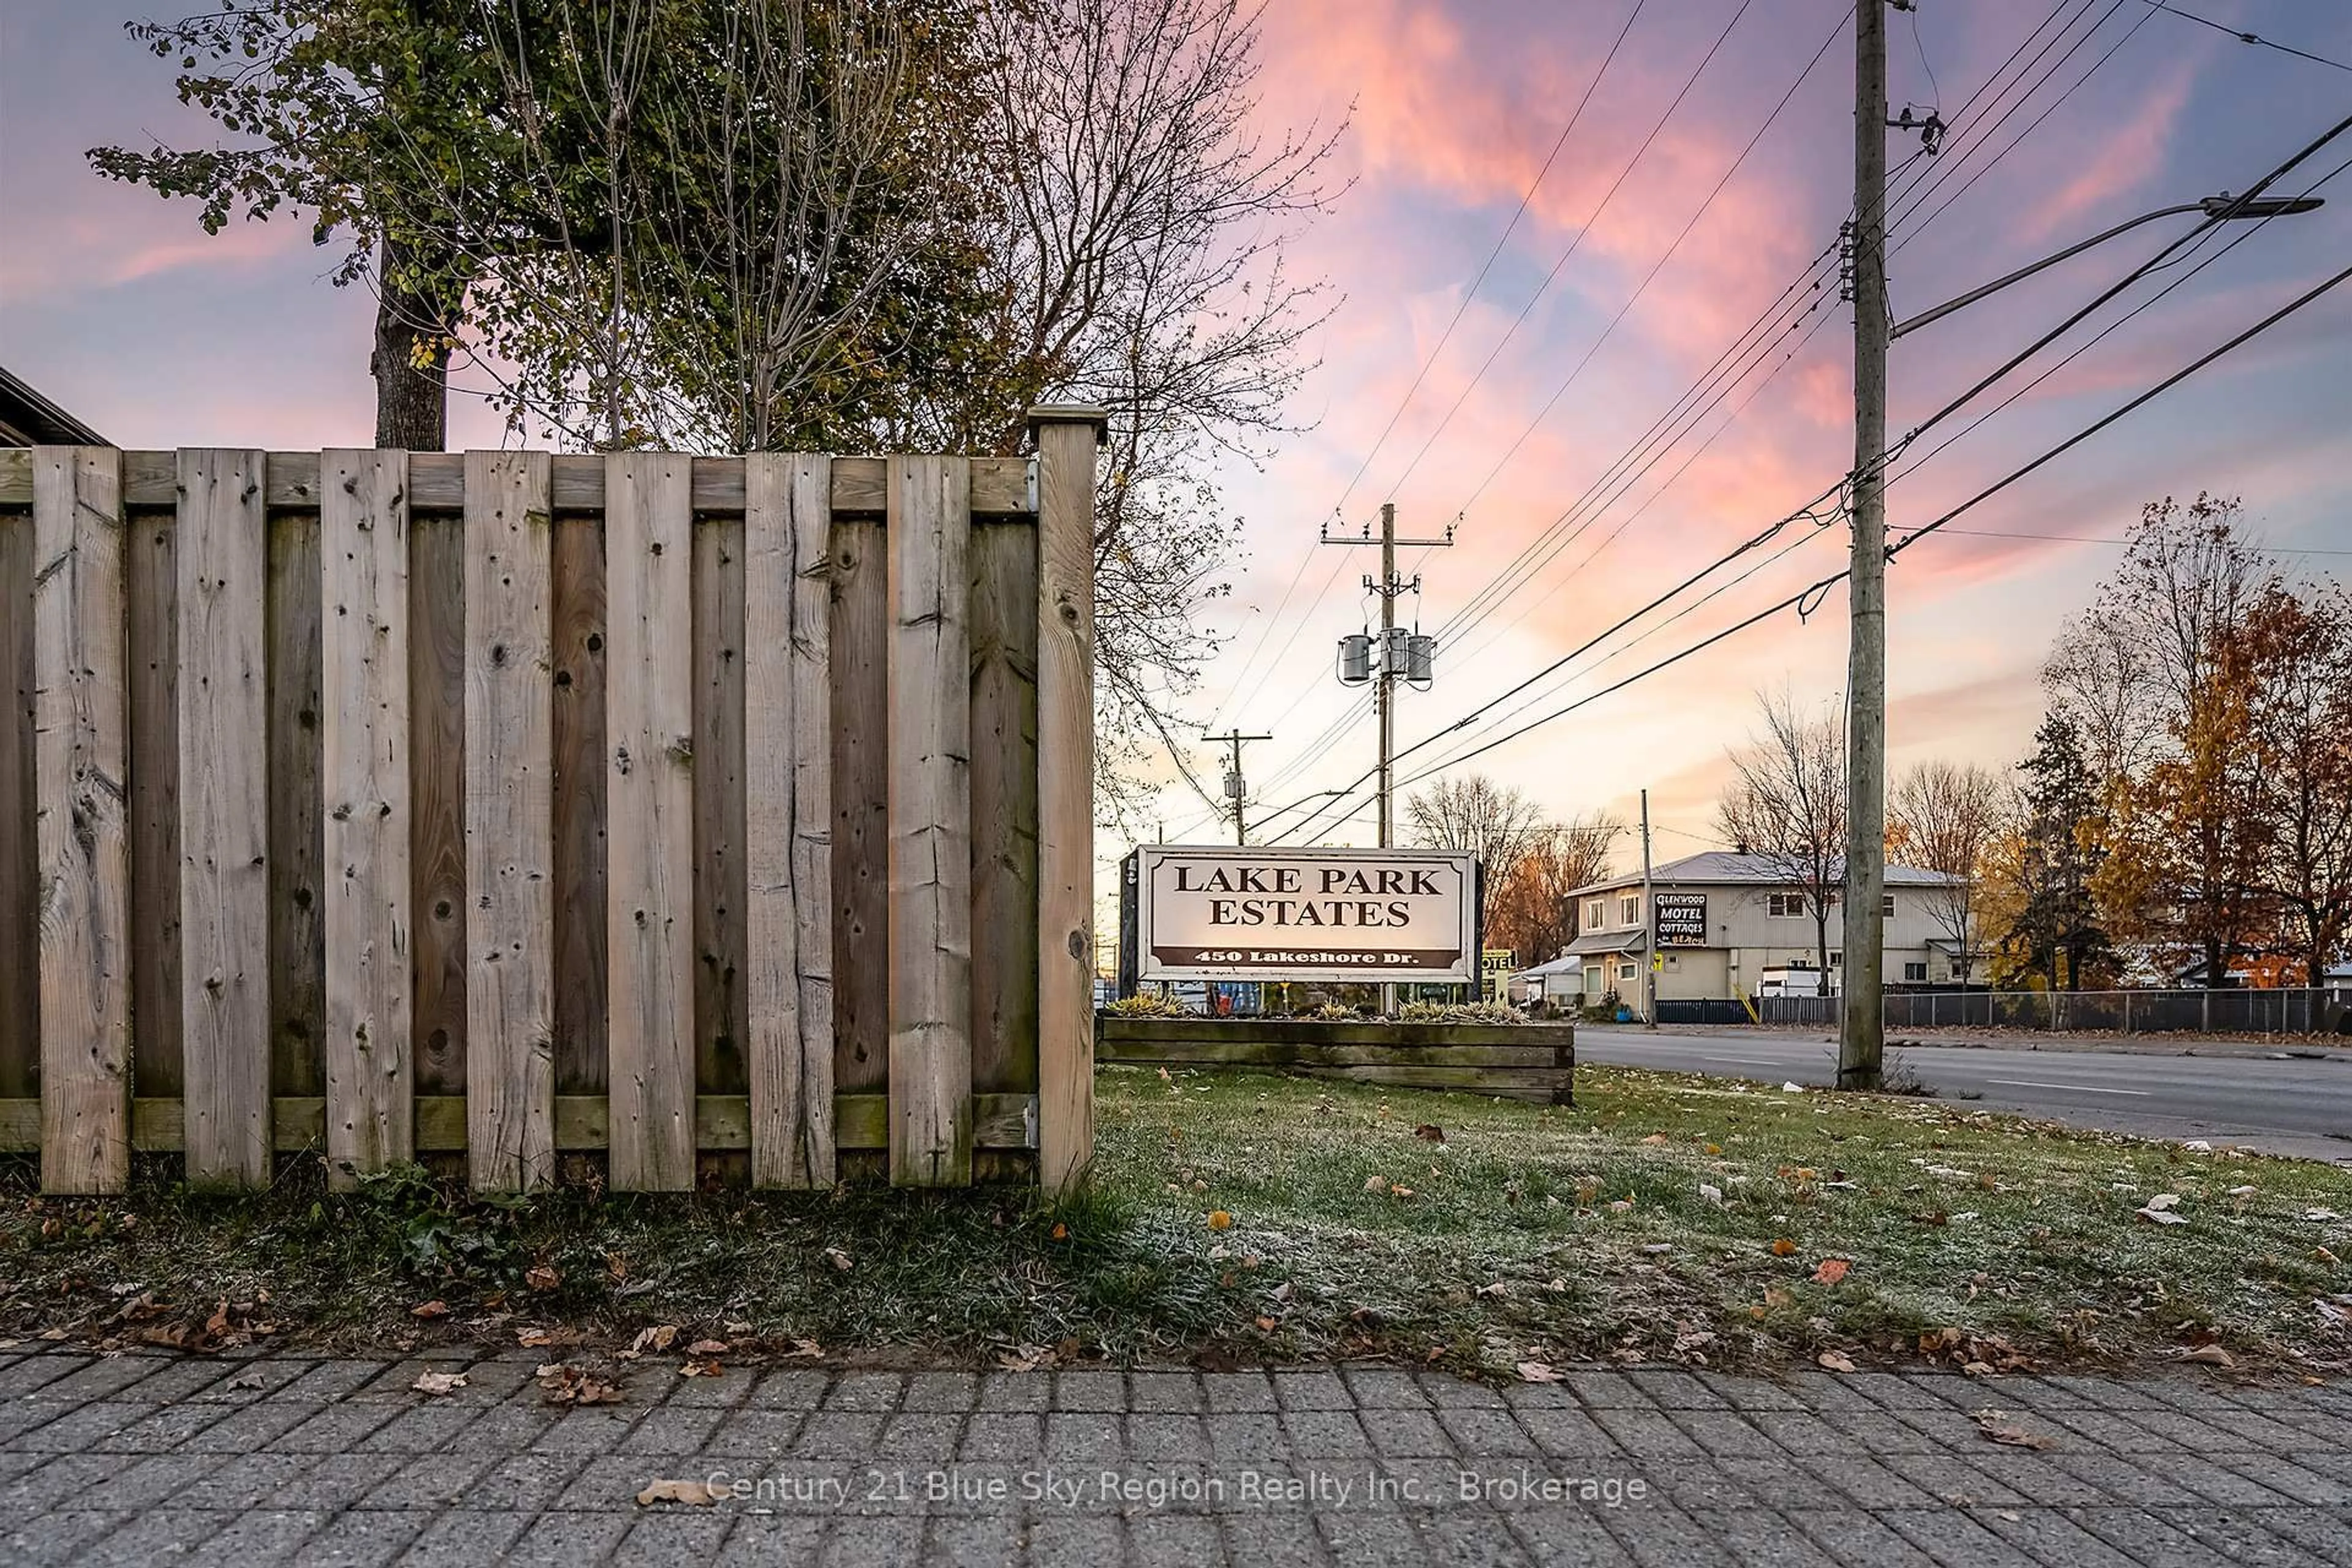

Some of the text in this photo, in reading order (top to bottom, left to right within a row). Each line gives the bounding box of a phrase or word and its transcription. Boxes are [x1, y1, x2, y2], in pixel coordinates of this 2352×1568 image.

[1174, 866, 1443, 895] LAKE PARK
[1657, 895, 1705, 906] GLENWOOD
[1208, 899, 1410, 927] ESTATES
[1660, 908, 1702, 919] MOTEL
[1659, 922, 1703, 935] COTTAGES
[1194, 951, 1420, 963] 450 Lakeshore Dr.
[1481, 957, 1515, 969] OTEL
